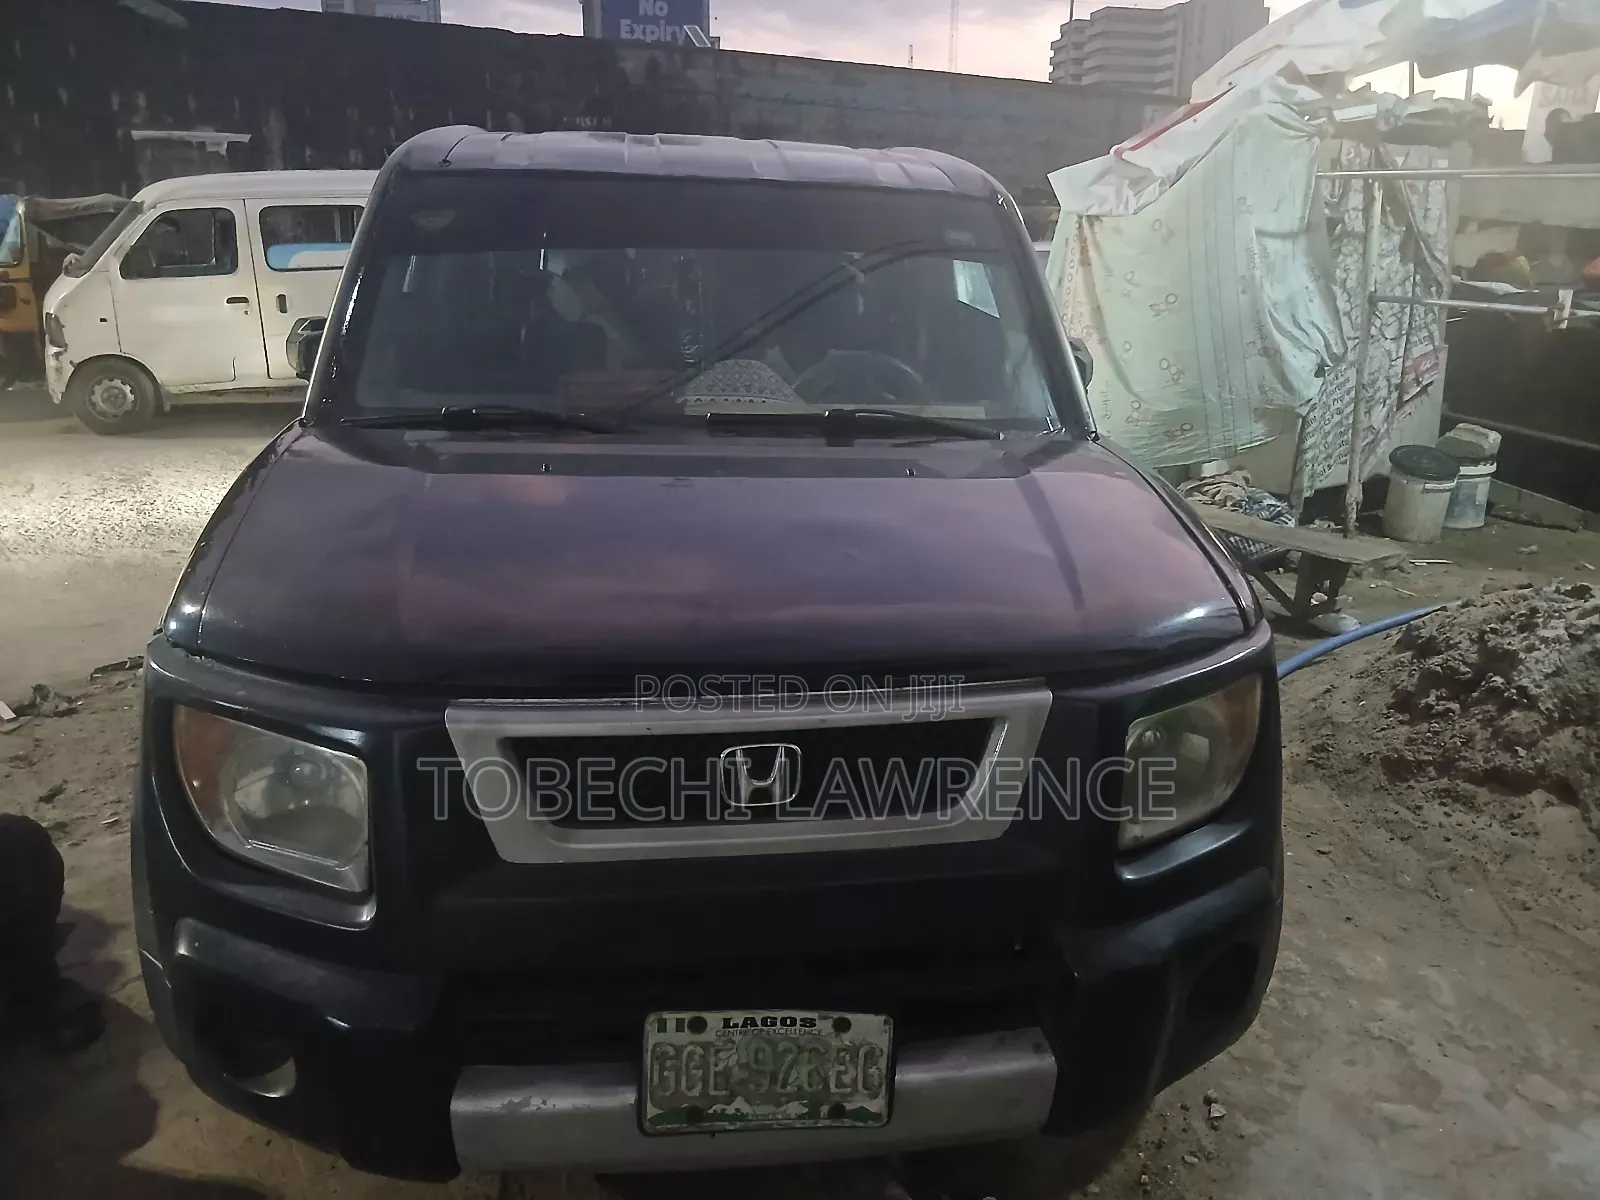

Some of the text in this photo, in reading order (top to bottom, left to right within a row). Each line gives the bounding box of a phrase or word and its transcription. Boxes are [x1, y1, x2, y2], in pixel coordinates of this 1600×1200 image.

[639, 0, 668, 16] No
[620, 18, 686, 45] Expiry
[722, 1016, 817, 1029] LAGOS
[715, 1027, 822, 1037] CENTRE OF EXCELLENCE
